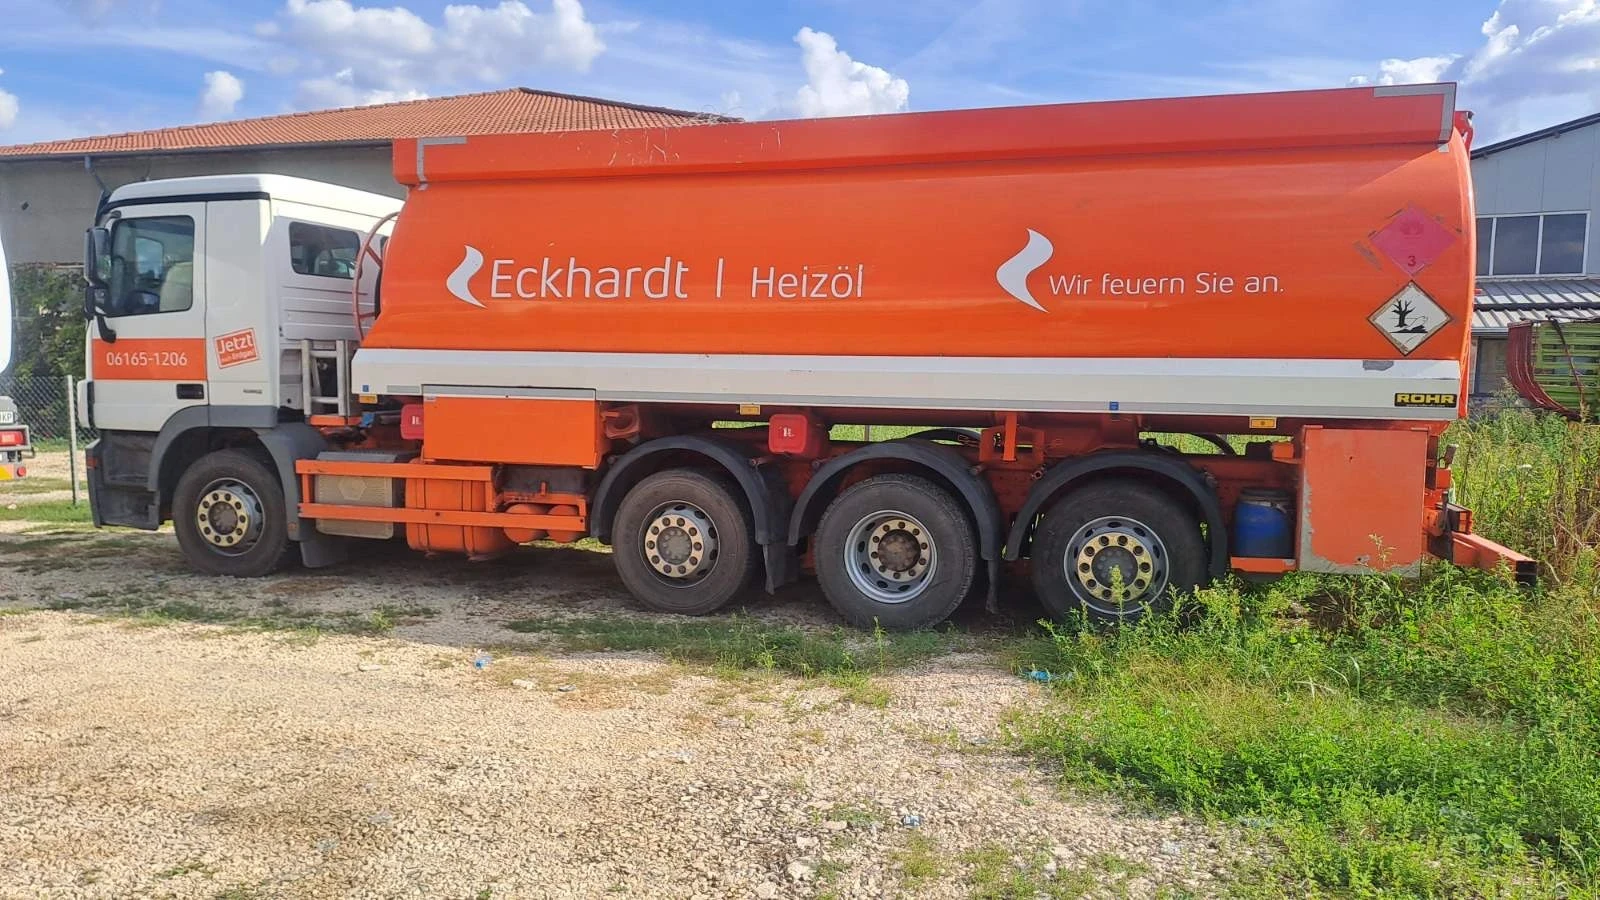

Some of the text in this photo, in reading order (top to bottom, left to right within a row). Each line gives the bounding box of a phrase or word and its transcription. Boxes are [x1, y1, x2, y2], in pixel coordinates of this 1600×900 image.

[1407, 255, 1417, 268] 3
[489, 256, 689, 299] Eckhardt
[751, 264, 865, 298] Heizöl
[1049, 272, 1285, 296] Wir feuern Sie an.
[218, 333, 254, 354] Jetzt
[106, 351, 188, 367] 06165-1206
[1396, 393, 1455, 404] ROHR
